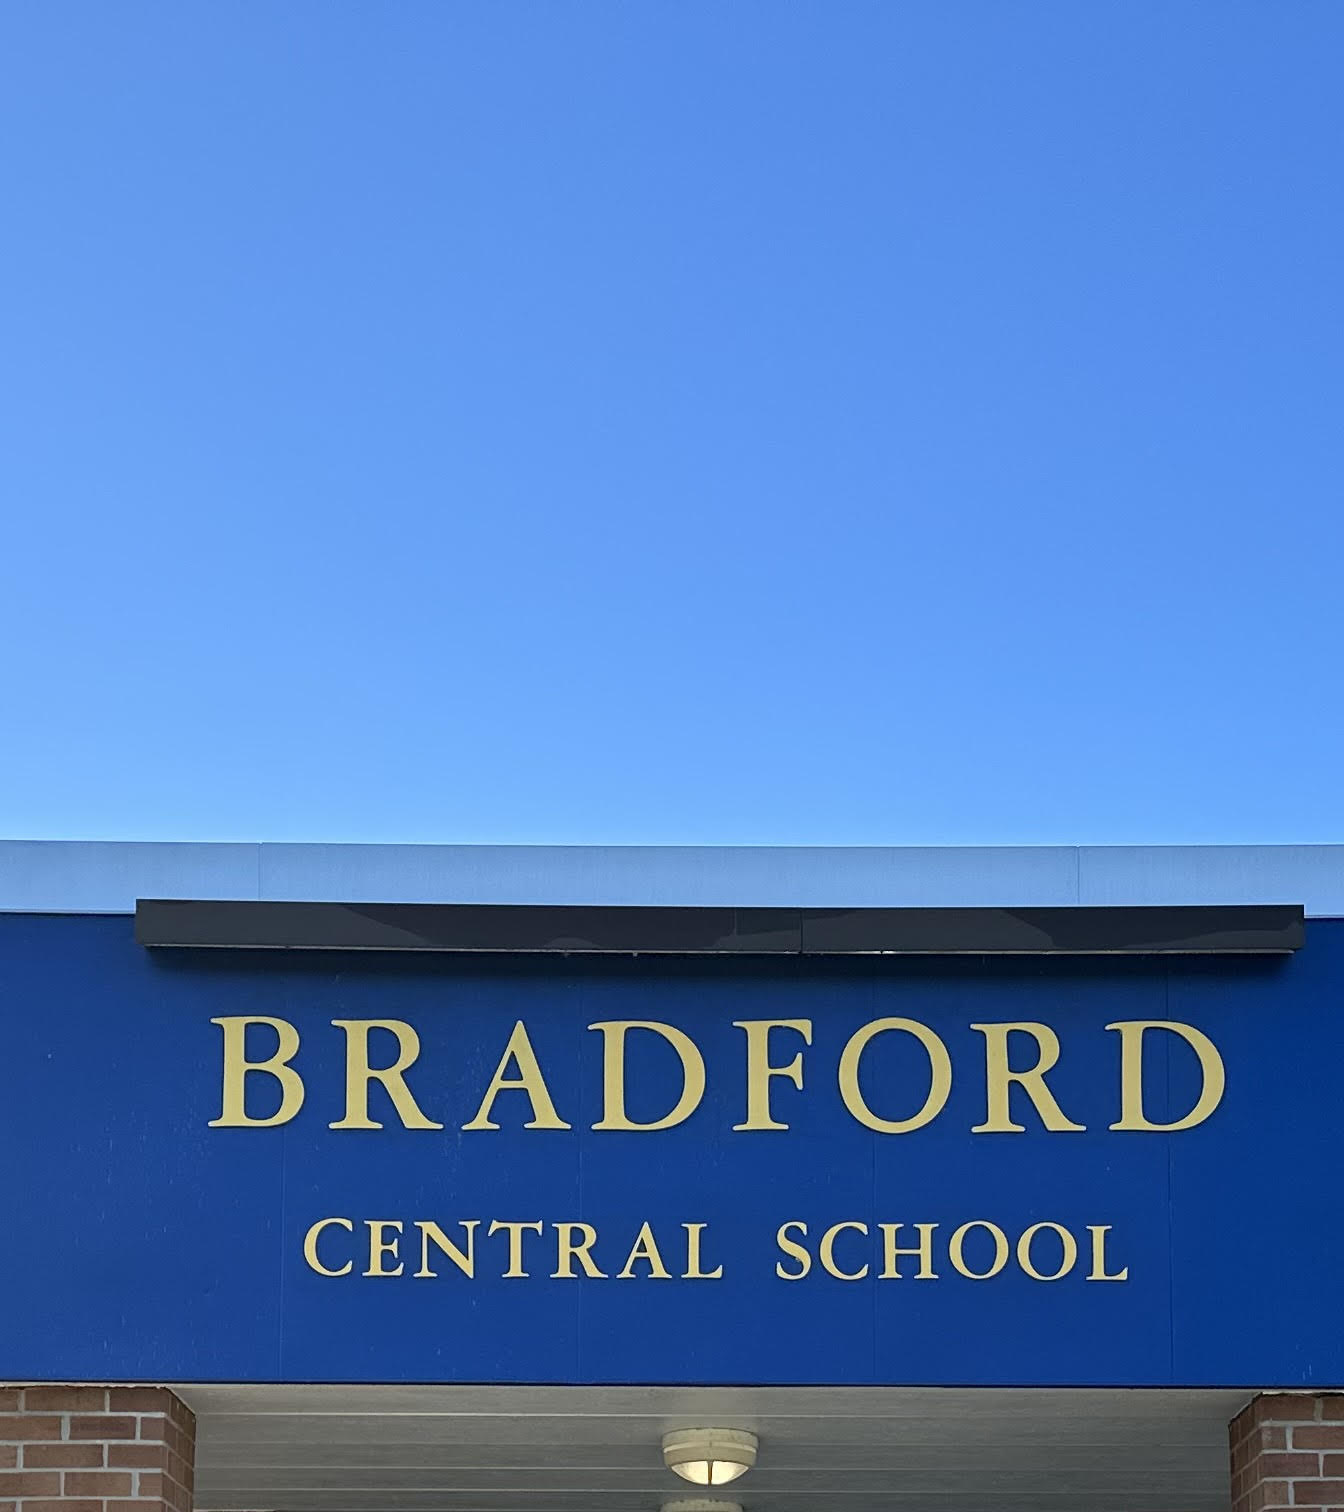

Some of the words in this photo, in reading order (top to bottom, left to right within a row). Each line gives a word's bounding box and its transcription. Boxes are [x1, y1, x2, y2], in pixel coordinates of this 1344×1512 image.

[209, 1016, 1226, 1133] BRADFORD
[302, 1218, 723, 1280] CENTRAL
[775, 1222, 1130, 1283] SCHOOL
